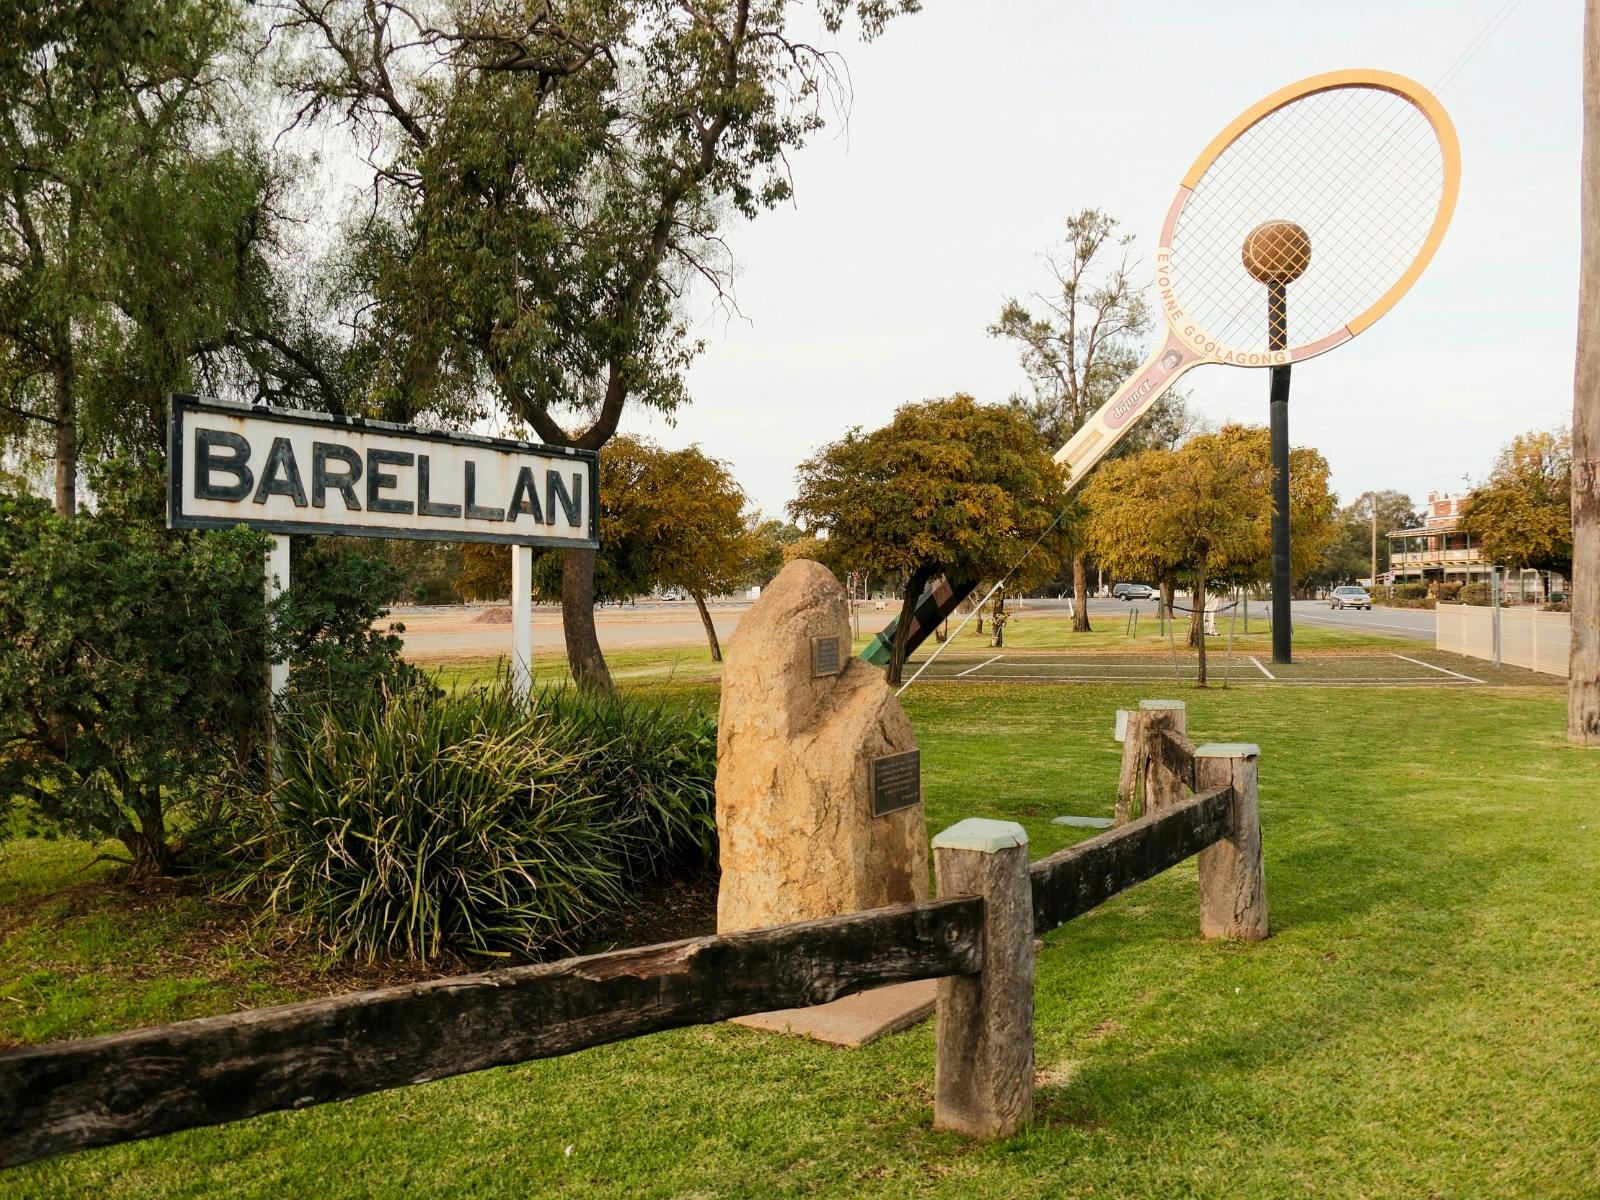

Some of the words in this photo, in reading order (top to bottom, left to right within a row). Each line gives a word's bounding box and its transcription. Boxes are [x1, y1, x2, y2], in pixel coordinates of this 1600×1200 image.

[1158, 253, 1183, 321] EVONNE
[1185, 325, 1285, 365] GOOLAGONG
[1113, 379, 1157, 419] Dunlop
[194, 427, 582, 527] BARELLAN
